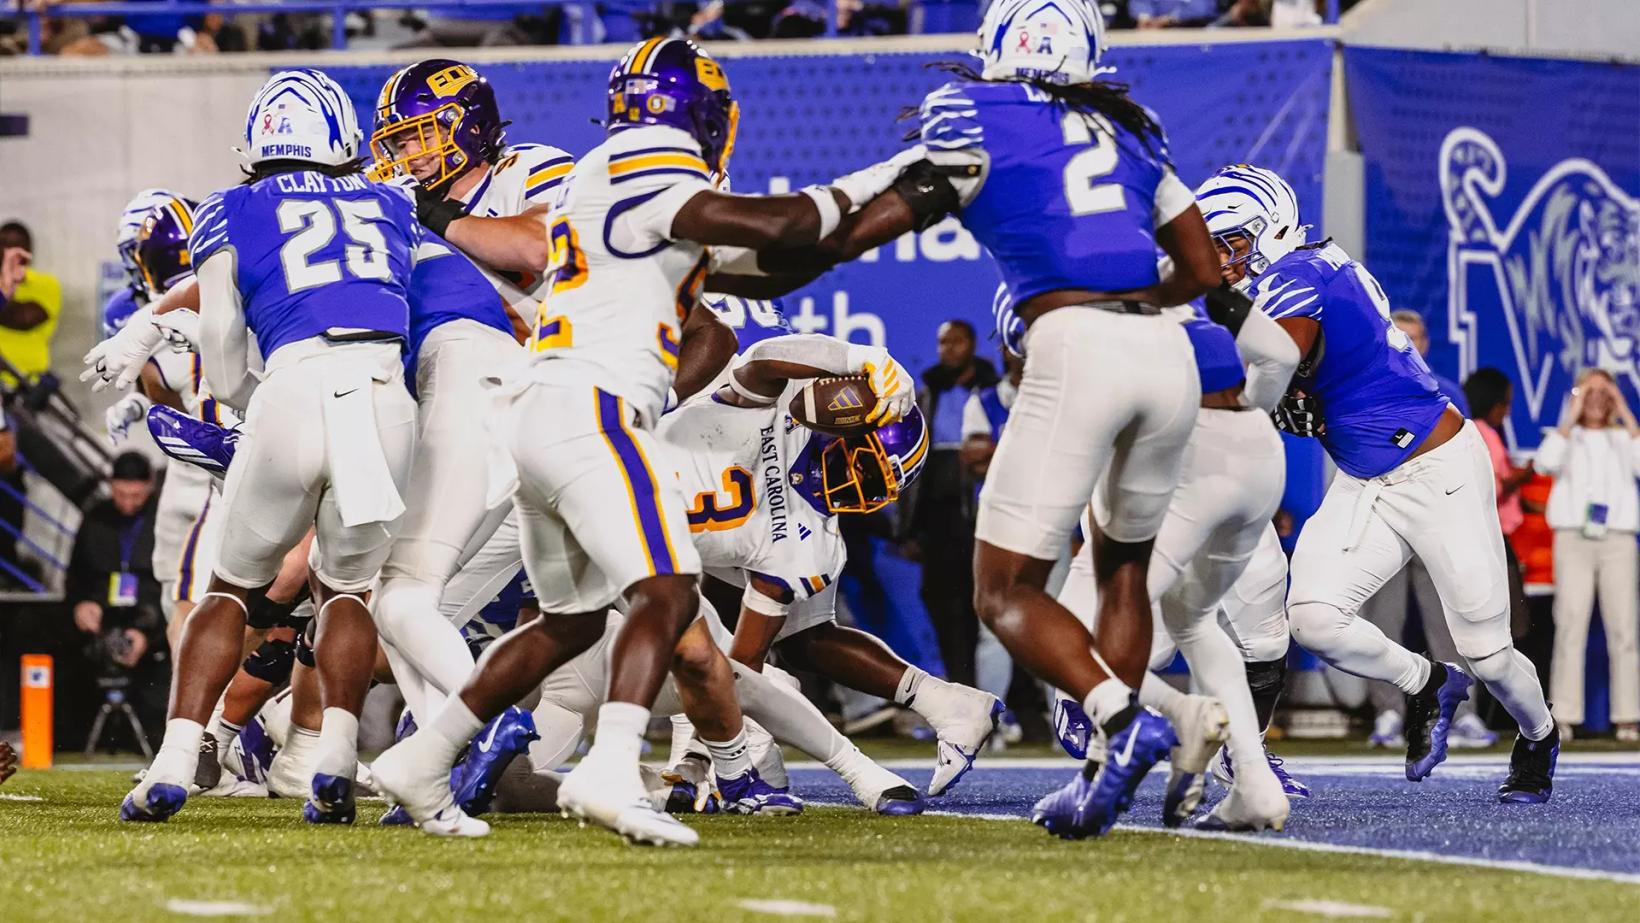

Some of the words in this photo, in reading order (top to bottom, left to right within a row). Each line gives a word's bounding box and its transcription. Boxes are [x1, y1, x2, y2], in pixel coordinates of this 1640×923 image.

[262, 144, 312, 158] MEMPHIS
[277, 170, 368, 193] CLAYTON
[1061, 110, 1127, 217] 2
[276, 197, 393, 295] 25
[760, 424, 779, 463] EAST
[675, 466, 757, 534] 3
[764, 465, 788, 544] CAROLINA
